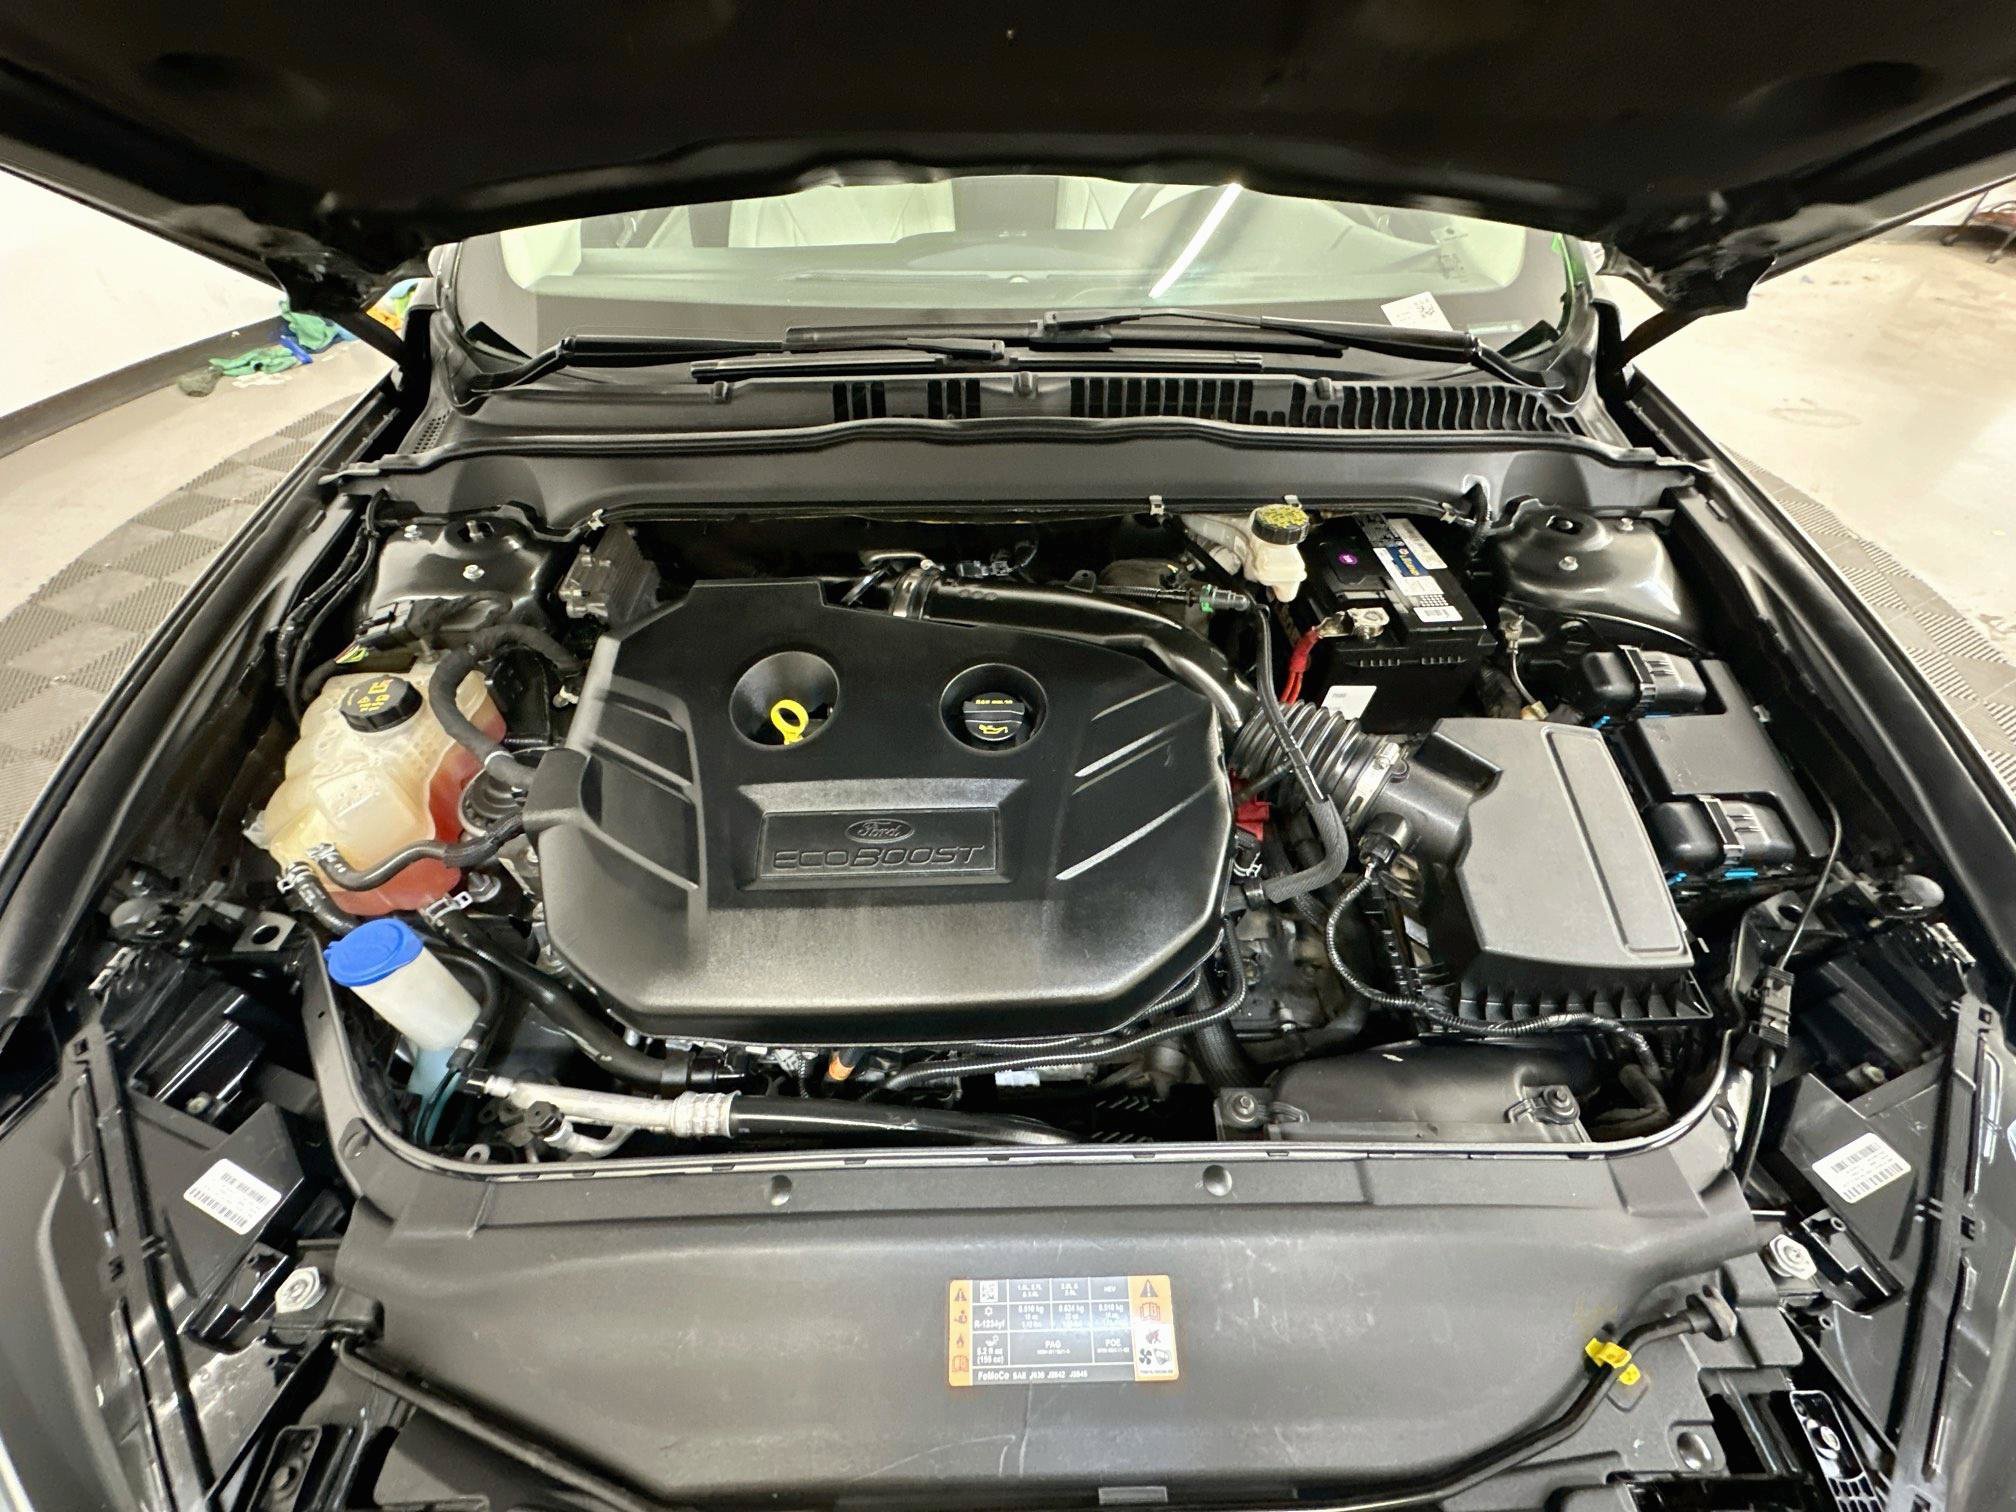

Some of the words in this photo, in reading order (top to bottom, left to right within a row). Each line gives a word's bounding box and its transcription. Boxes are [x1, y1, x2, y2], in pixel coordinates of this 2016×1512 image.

[858, 819, 902, 838] Ford
[773, 845, 985, 870] ECOBOOST
[977, 1370, 1010, 1380] FoMoCo
